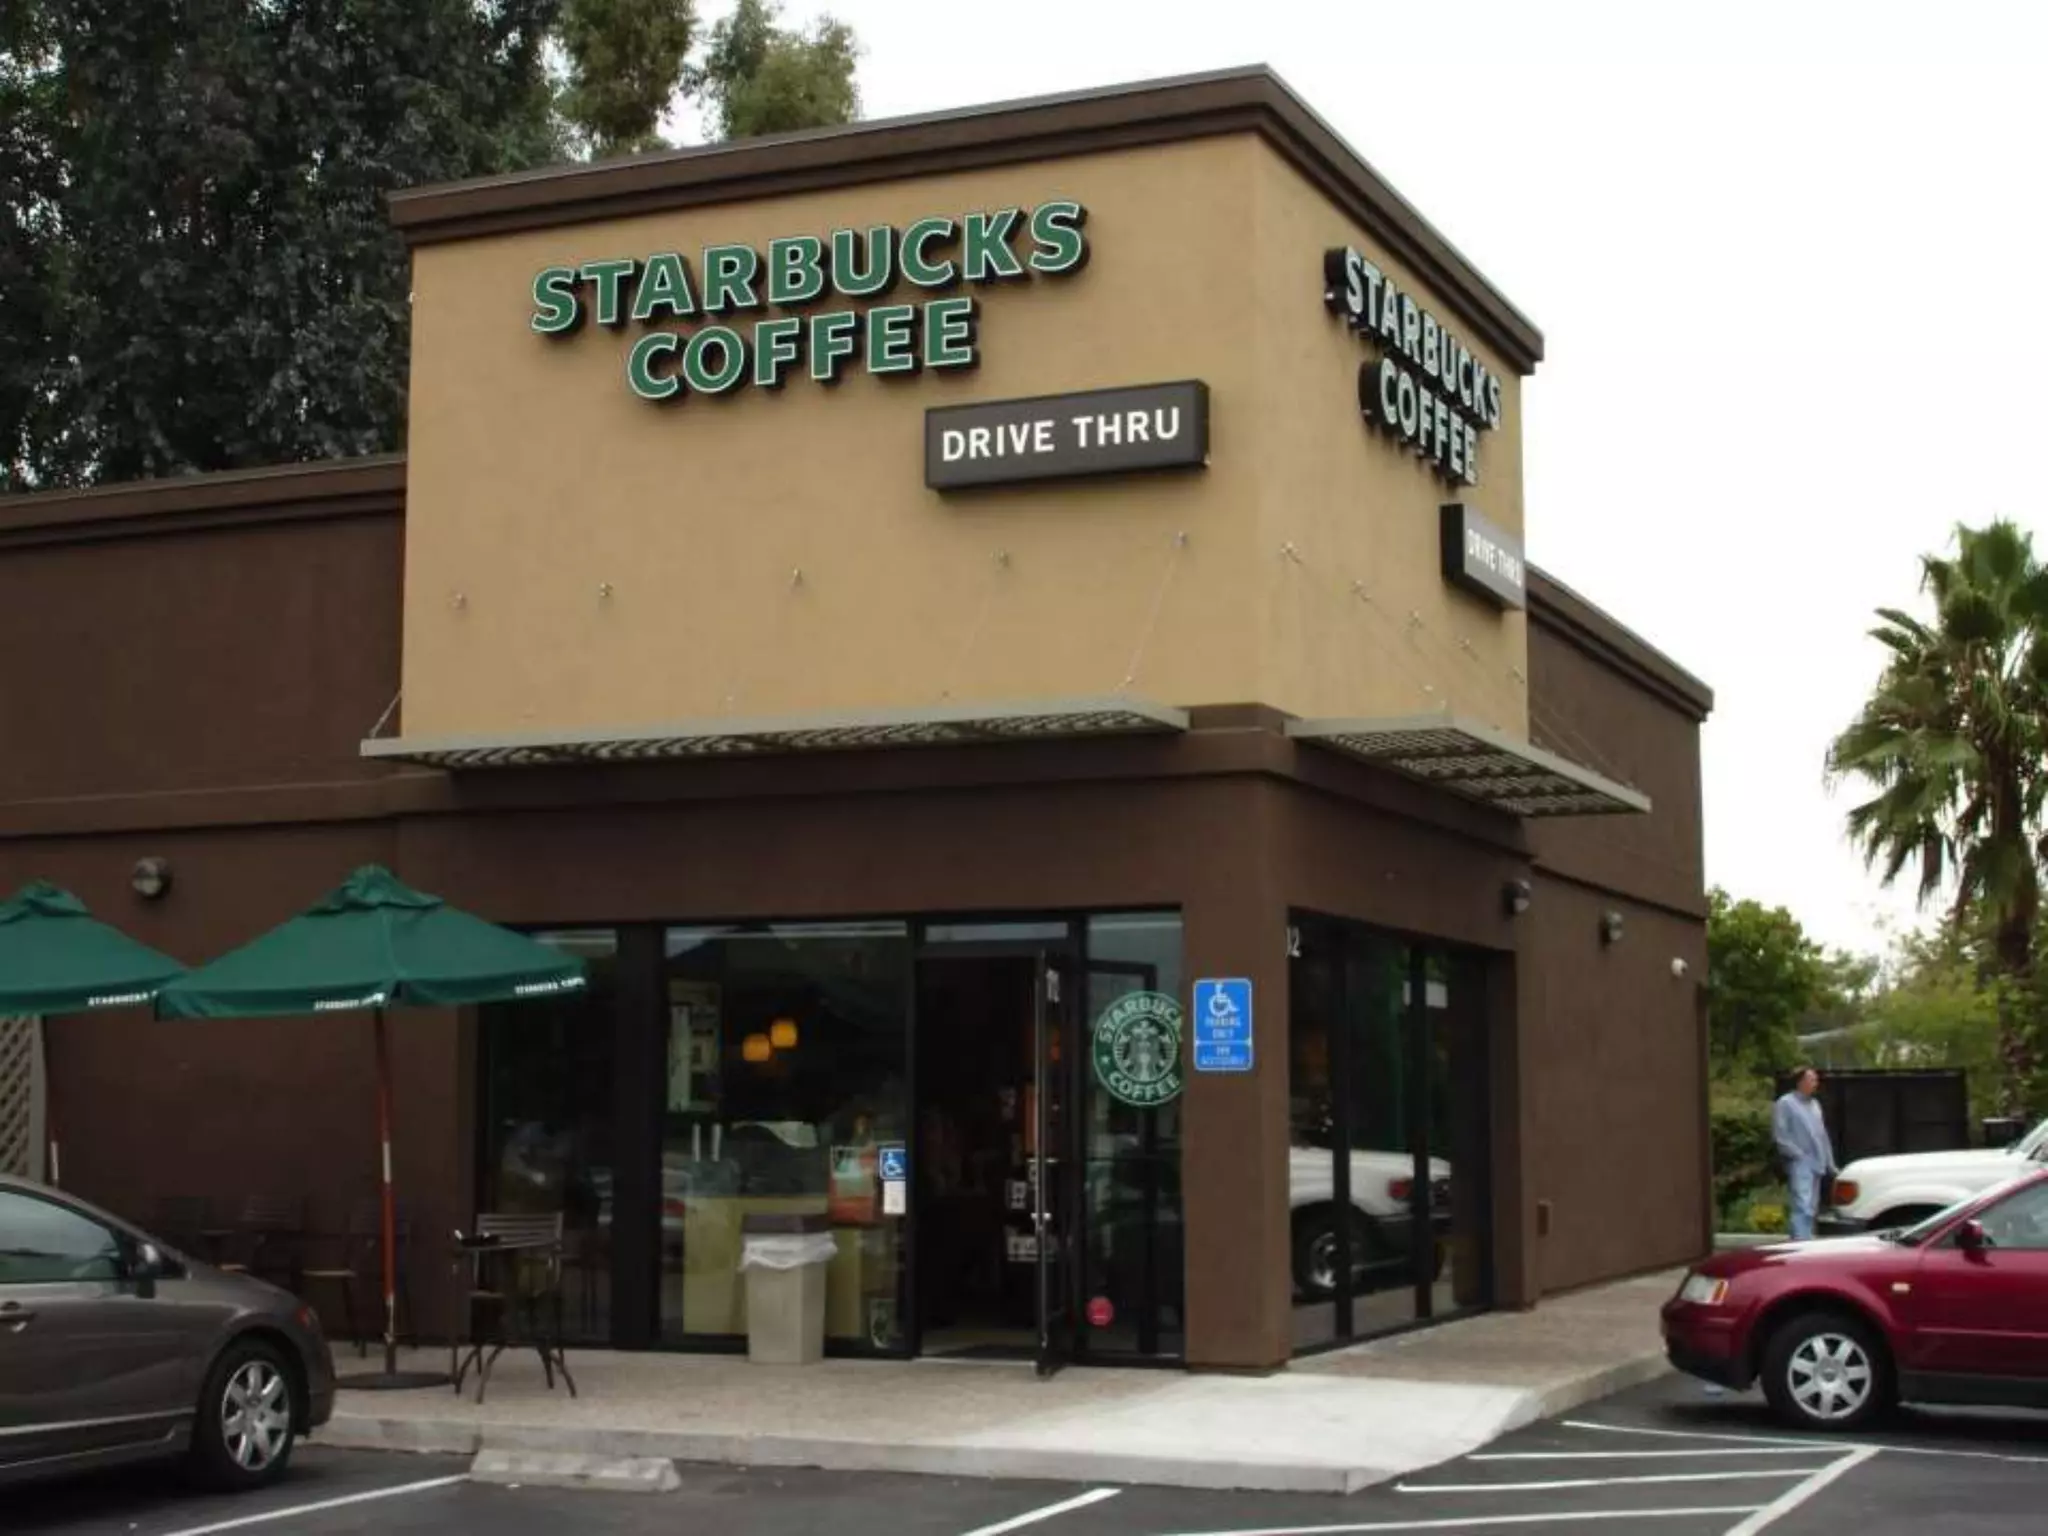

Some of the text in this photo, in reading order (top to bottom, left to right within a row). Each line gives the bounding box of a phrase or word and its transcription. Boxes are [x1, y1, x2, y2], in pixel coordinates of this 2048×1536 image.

[531, 202, 1088, 333] STARBUCKS
[627, 297, 975, 400] COFFEE
[1343, 245, 1501, 432] STARBUCKS
[941, 406, 1183, 463] DRIVE THRU
[1379, 357, 1478, 486] COFFEE
[1109, 1071, 1181, 1100] COFFEE
